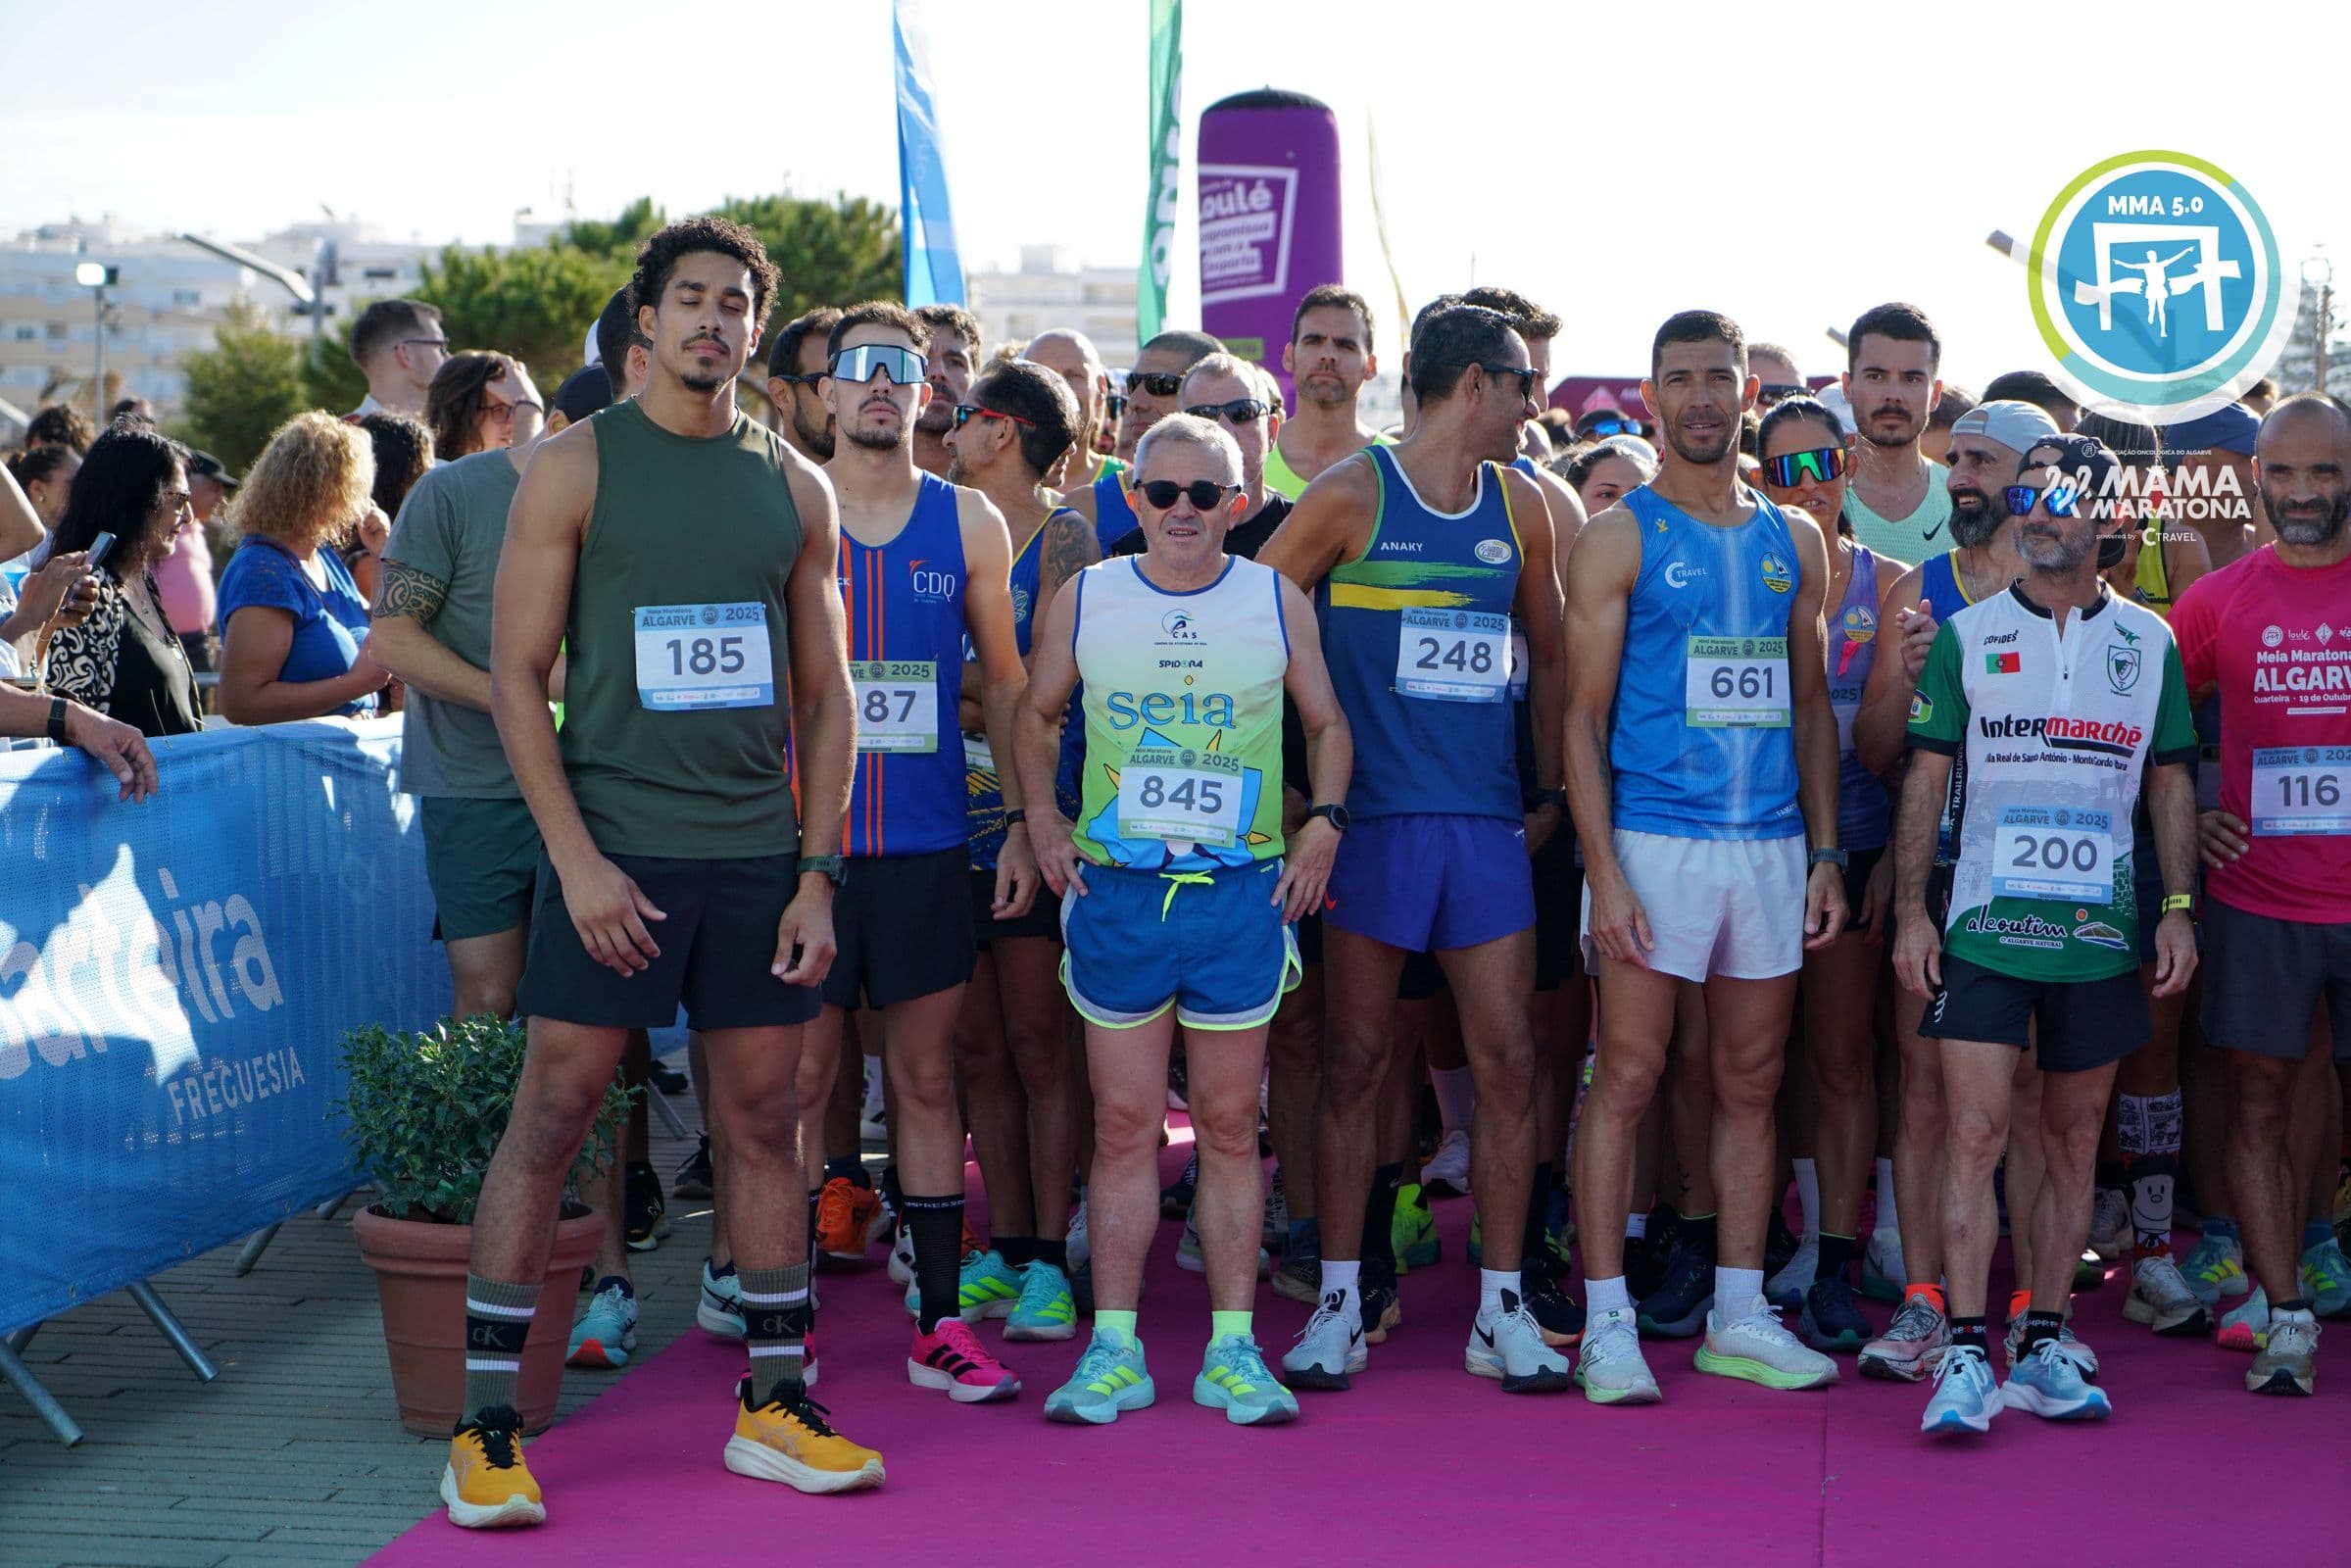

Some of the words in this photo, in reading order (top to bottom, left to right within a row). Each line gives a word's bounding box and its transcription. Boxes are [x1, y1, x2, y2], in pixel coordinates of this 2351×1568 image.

[1200, 178, 1273, 220] oulé
[1380, 541, 1424, 552] ANAKY
[913, 571, 955, 603] CDQ
[642, 615, 696, 627] ALGARVE
[725, 607, 759, 621] 2025
[1406, 615, 1450, 627] ALGARVE
[1473, 616, 1504, 632] 2025
[1693, 645, 1739, 656] ALGARVE
[1759, 641, 1784, 655] 2025
[1984, 632, 2017, 646] COFIDES
[666, 636, 745, 675] 185
[1416, 637, 1493, 674] 248
[2257, 651, 2288, 663] Meia
[891, 663, 930, 678] 2025
[2254, 665, 2351, 692] ALGARV
[1710, 666, 1773, 699] 661
[1106, 675, 1237, 729] seia
[1831, 688, 1858, 701] 025
[2254, 695, 2290, 704] Quarteira
[2299, 695, 2309, 704] 19
[2323, 693, 2351, 702] Outubr
[858, 690, 916, 722] 87
[1130, 755, 1176, 764] ALGARVE
[1202, 754, 1240, 771] 2025
[1996, 753, 2012, 762] Real
[2012, 753, 2021, 762] de
[2038, 752, 2068, 763] António
[2257, 755, 2300, 765] ALGARVE
[2326, 749, 2351, 761] 202
[1140, 775, 1223, 814] 845
[2278, 774, 2340, 807] 116
[2003, 814, 2050, 825] ALGARVE
[2076, 813, 2108, 830] 2025
[2012, 834, 2098, 872] 200
[1966, 904, 2068, 938] alcoutim
[167, 1046, 306, 1126] FREGUESIA
